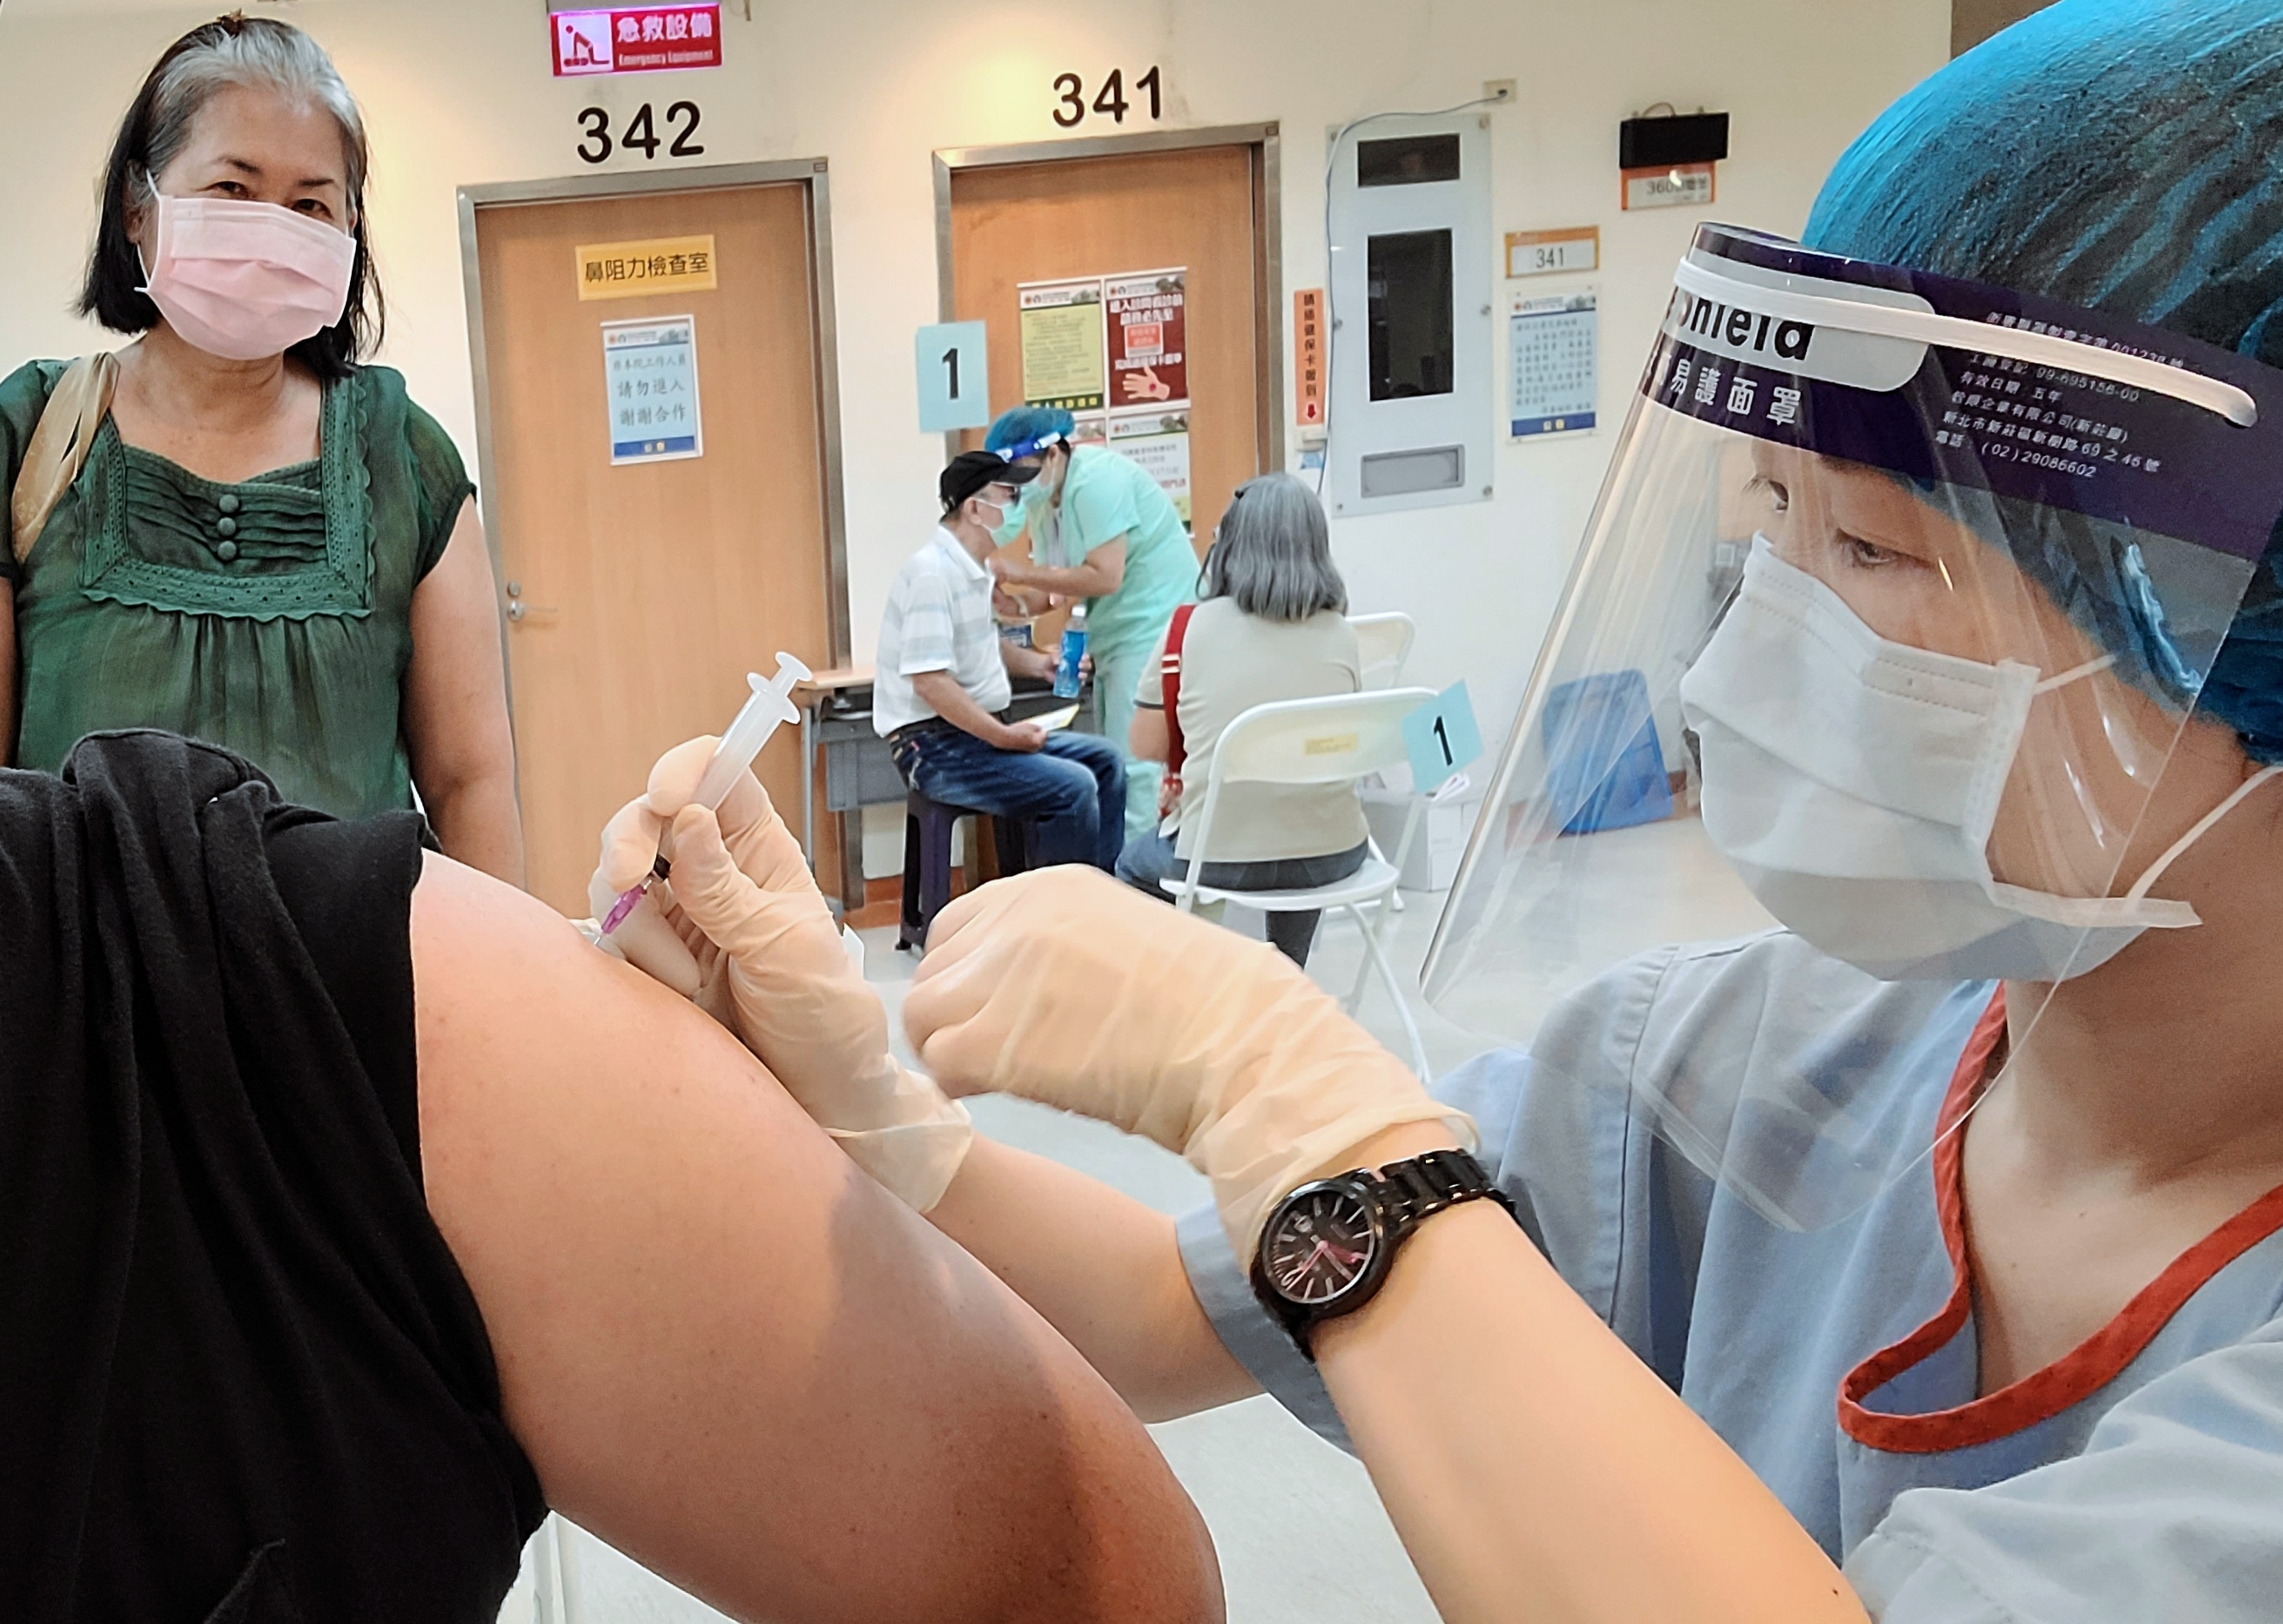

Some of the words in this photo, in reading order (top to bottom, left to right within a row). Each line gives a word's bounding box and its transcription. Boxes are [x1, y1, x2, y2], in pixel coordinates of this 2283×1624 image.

[617, 12, 712, 42] 急救設備
[1053, 66, 1160, 126] 341
[577, 101, 704, 163] 342
[585, 252, 710, 283] 鼻阻力檢查室
[1536, 247, 1564, 269] 341
[617, 378, 685, 399] 請勿進入
[942, 347, 959, 400] 1
[1661, 355, 1801, 426] 易護面罩
[620, 405, 686, 426] 謝謝合作
[1433, 715, 1454, 766] 1
